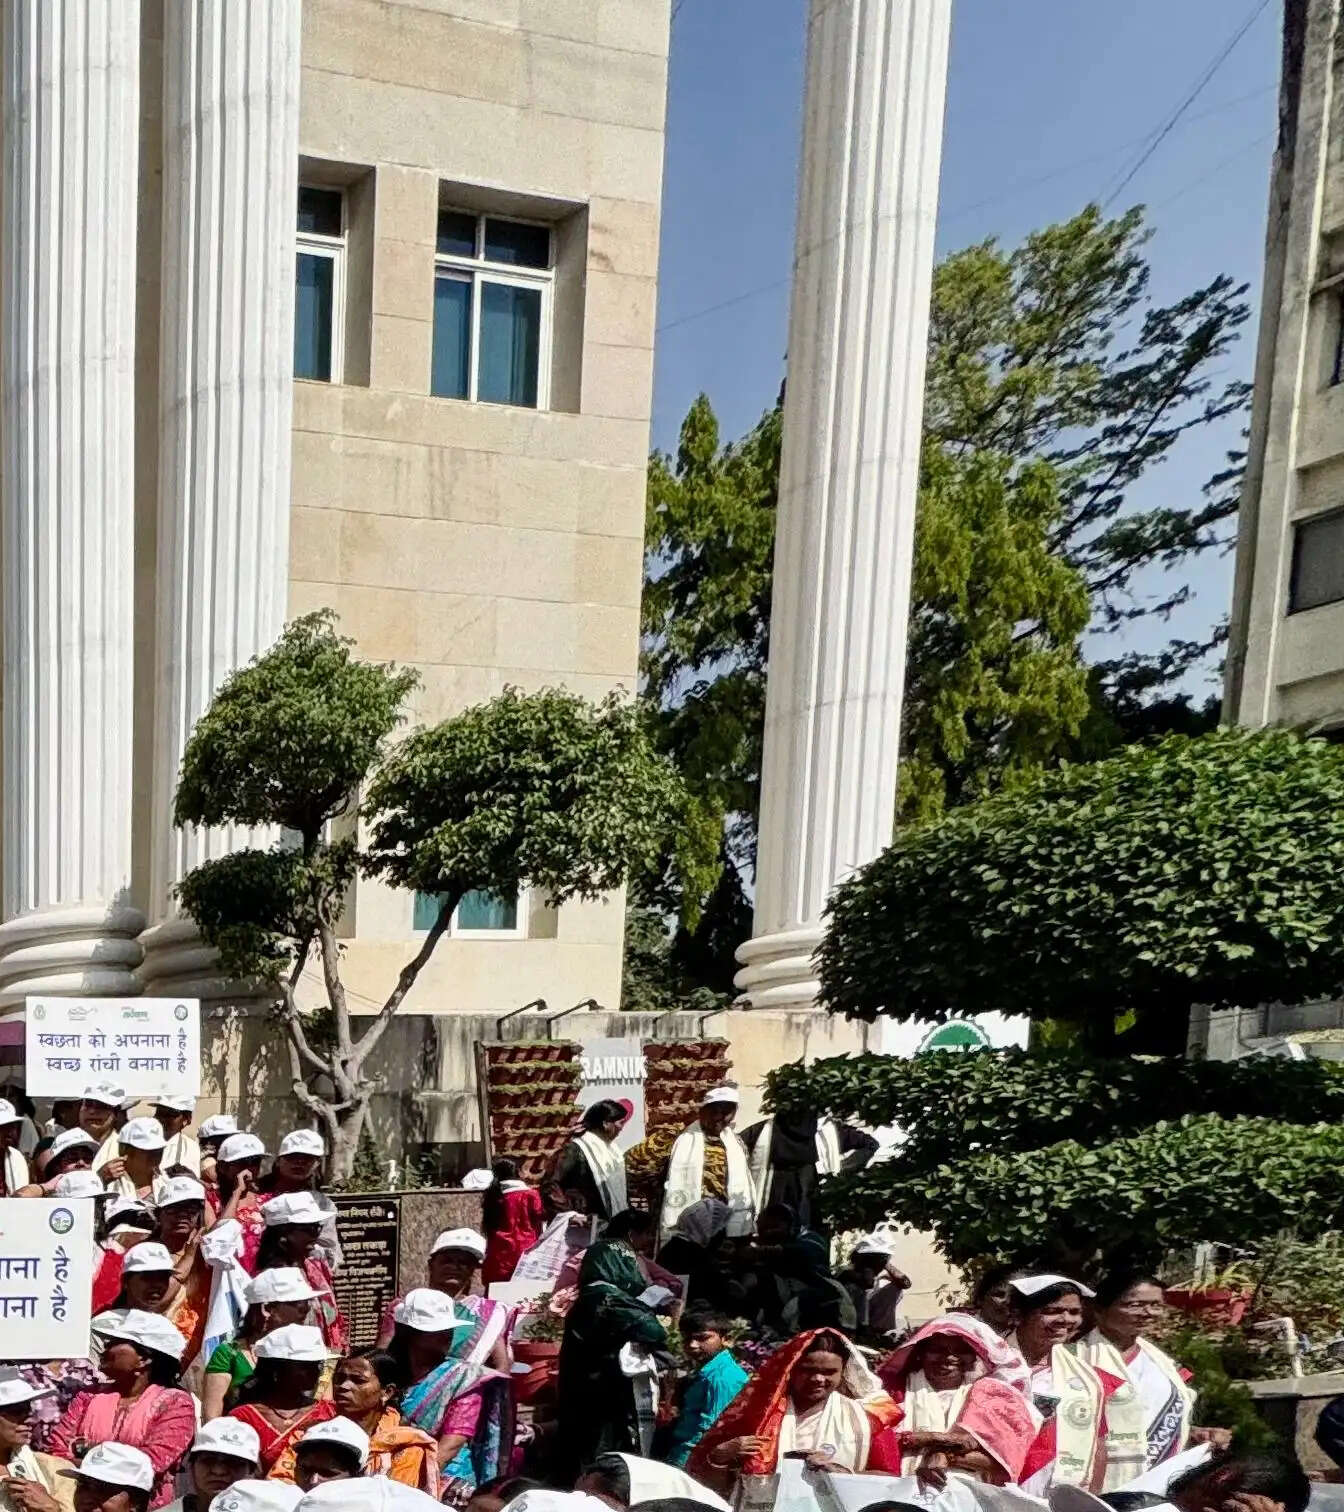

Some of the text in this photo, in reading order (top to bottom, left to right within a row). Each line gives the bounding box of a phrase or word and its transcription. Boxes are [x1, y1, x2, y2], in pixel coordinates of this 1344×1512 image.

[88, 1028, 107, 1049] को
[114, 1034, 171, 1049] अपनाना
[176, 1027, 187, 1050] है
[45, 1057, 81, 1072] स्वच्छ
[89, 1052, 121, 1072] रांची
[177, 1052, 187, 1073] है
[579, 1055, 648, 1079] RAMNIK
[52, 1245, 70, 1283] है
[50, 1285, 69, 1322] है
